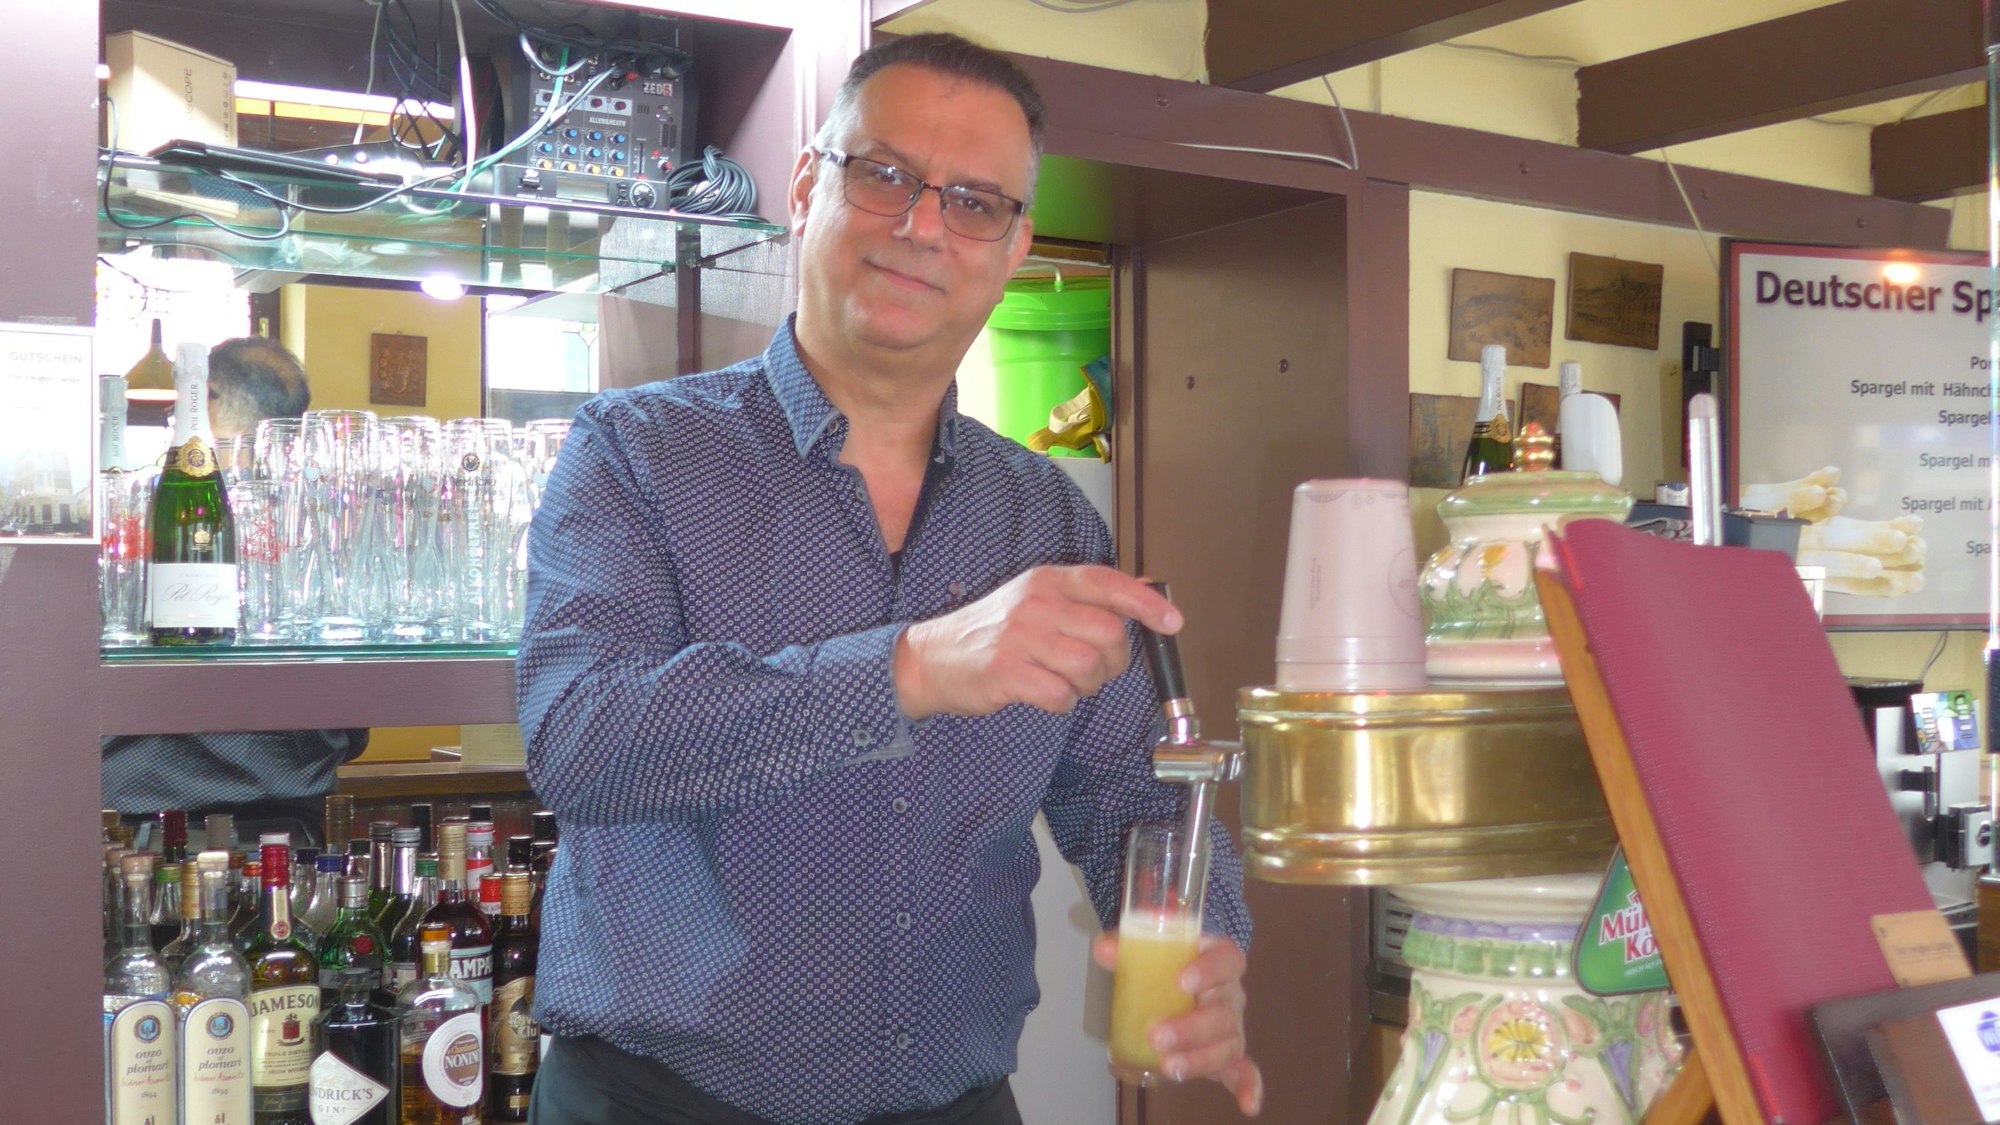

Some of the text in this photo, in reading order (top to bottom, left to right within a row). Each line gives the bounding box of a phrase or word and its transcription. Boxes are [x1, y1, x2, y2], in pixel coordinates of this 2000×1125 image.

[1755, 269, 1942, 312] Deutscher
[10, 350, 82, 364] GUTSCHEIN
[1850, 379, 1907, 398] Spargel
[1911, 381, 1935, 396] mit
[190, 383, 199, 414] ROGER
[1938, 409, 1991, 427] Spargel
[1919, 453, 1974, 470] Spargel
[1901, 496, 1956, 514] Spargel
[1960, 497, 1984, 511] mit
[1966, 540, 1991, 557] Spa
[135, 1049, 162, 1060] ouzo
[207, 1046, 235, 1056] ouzo
